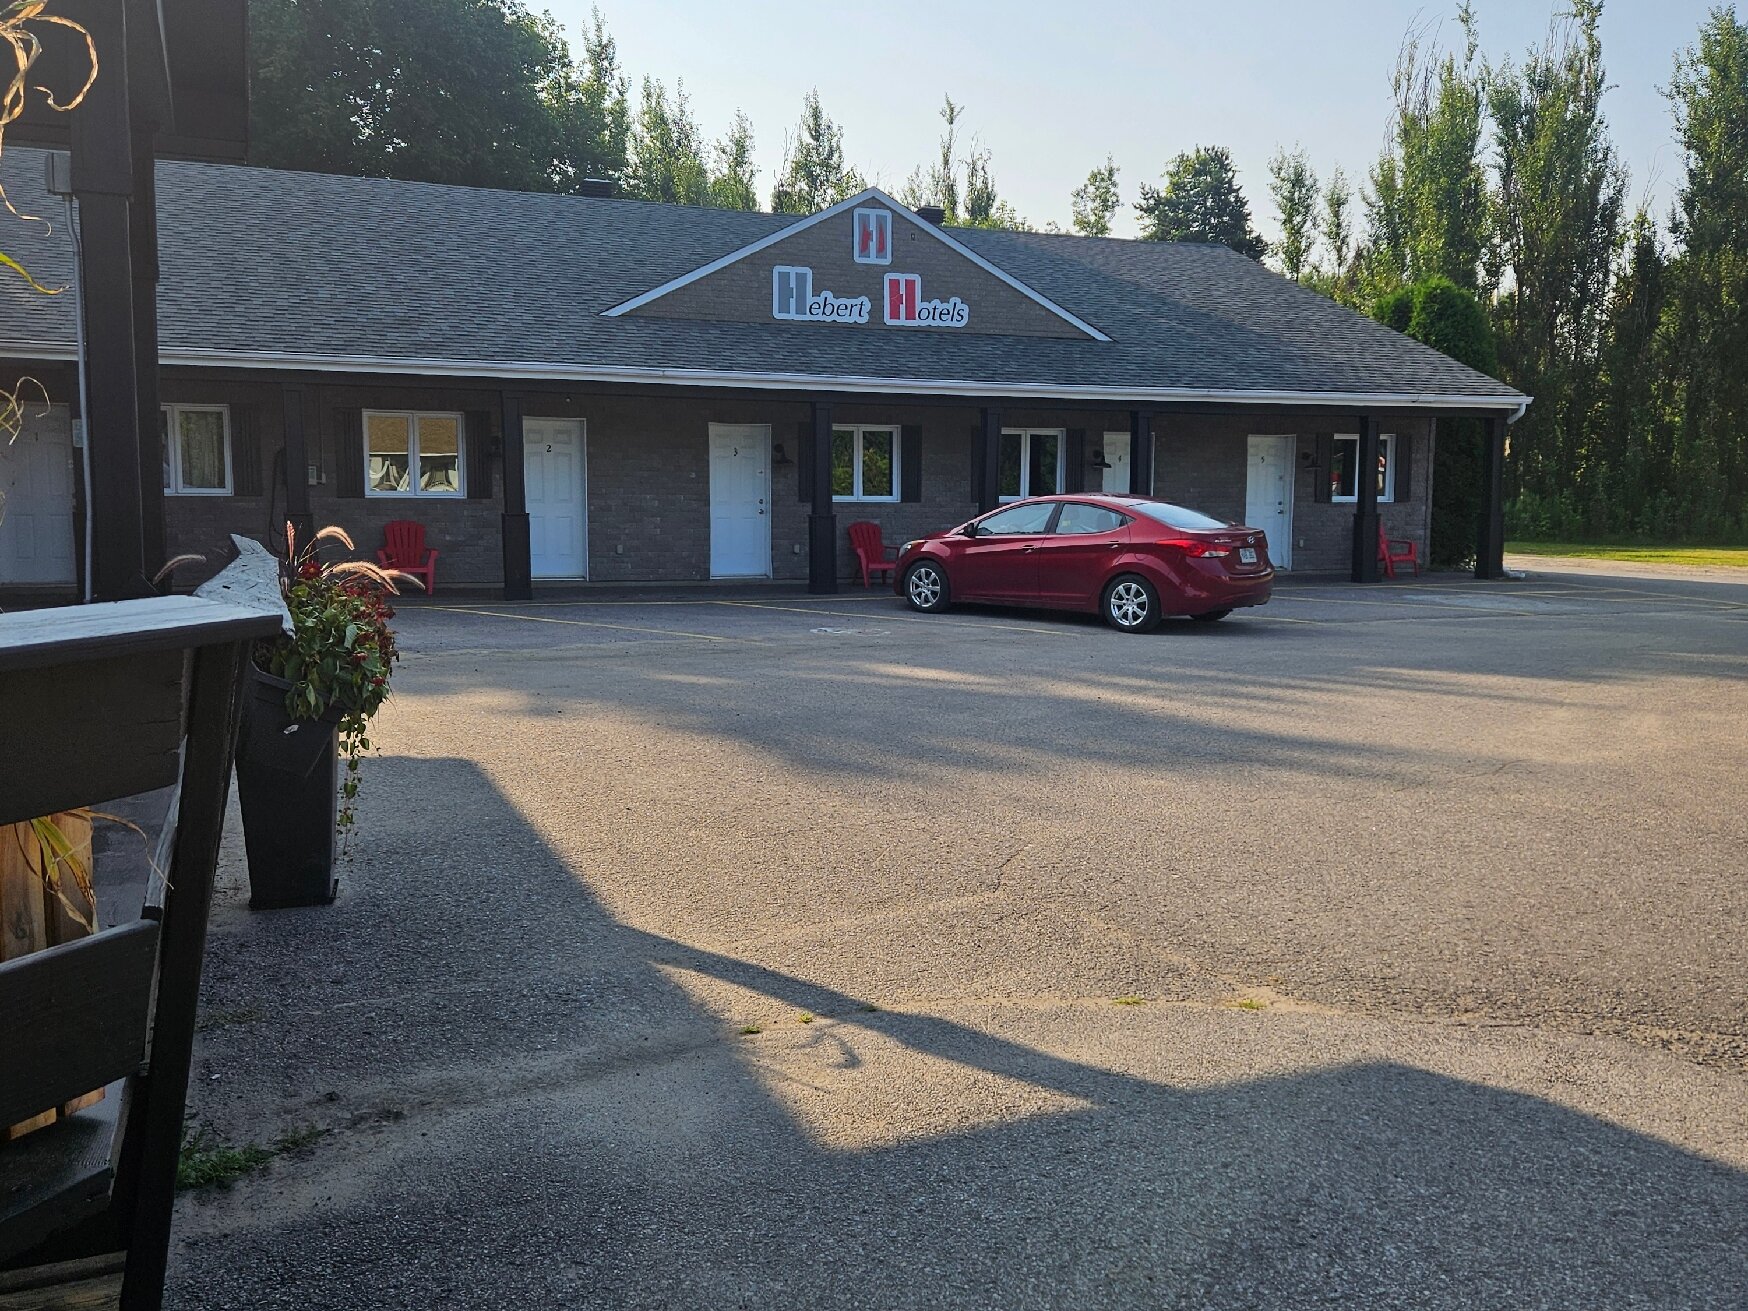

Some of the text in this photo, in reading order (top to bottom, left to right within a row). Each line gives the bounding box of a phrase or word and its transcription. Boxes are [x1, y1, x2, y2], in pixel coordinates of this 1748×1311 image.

[777, 271, 966, 323] Hebert Hotels
[546, 444, 552, 453] 2
[733, 447, 738, 457] 3
